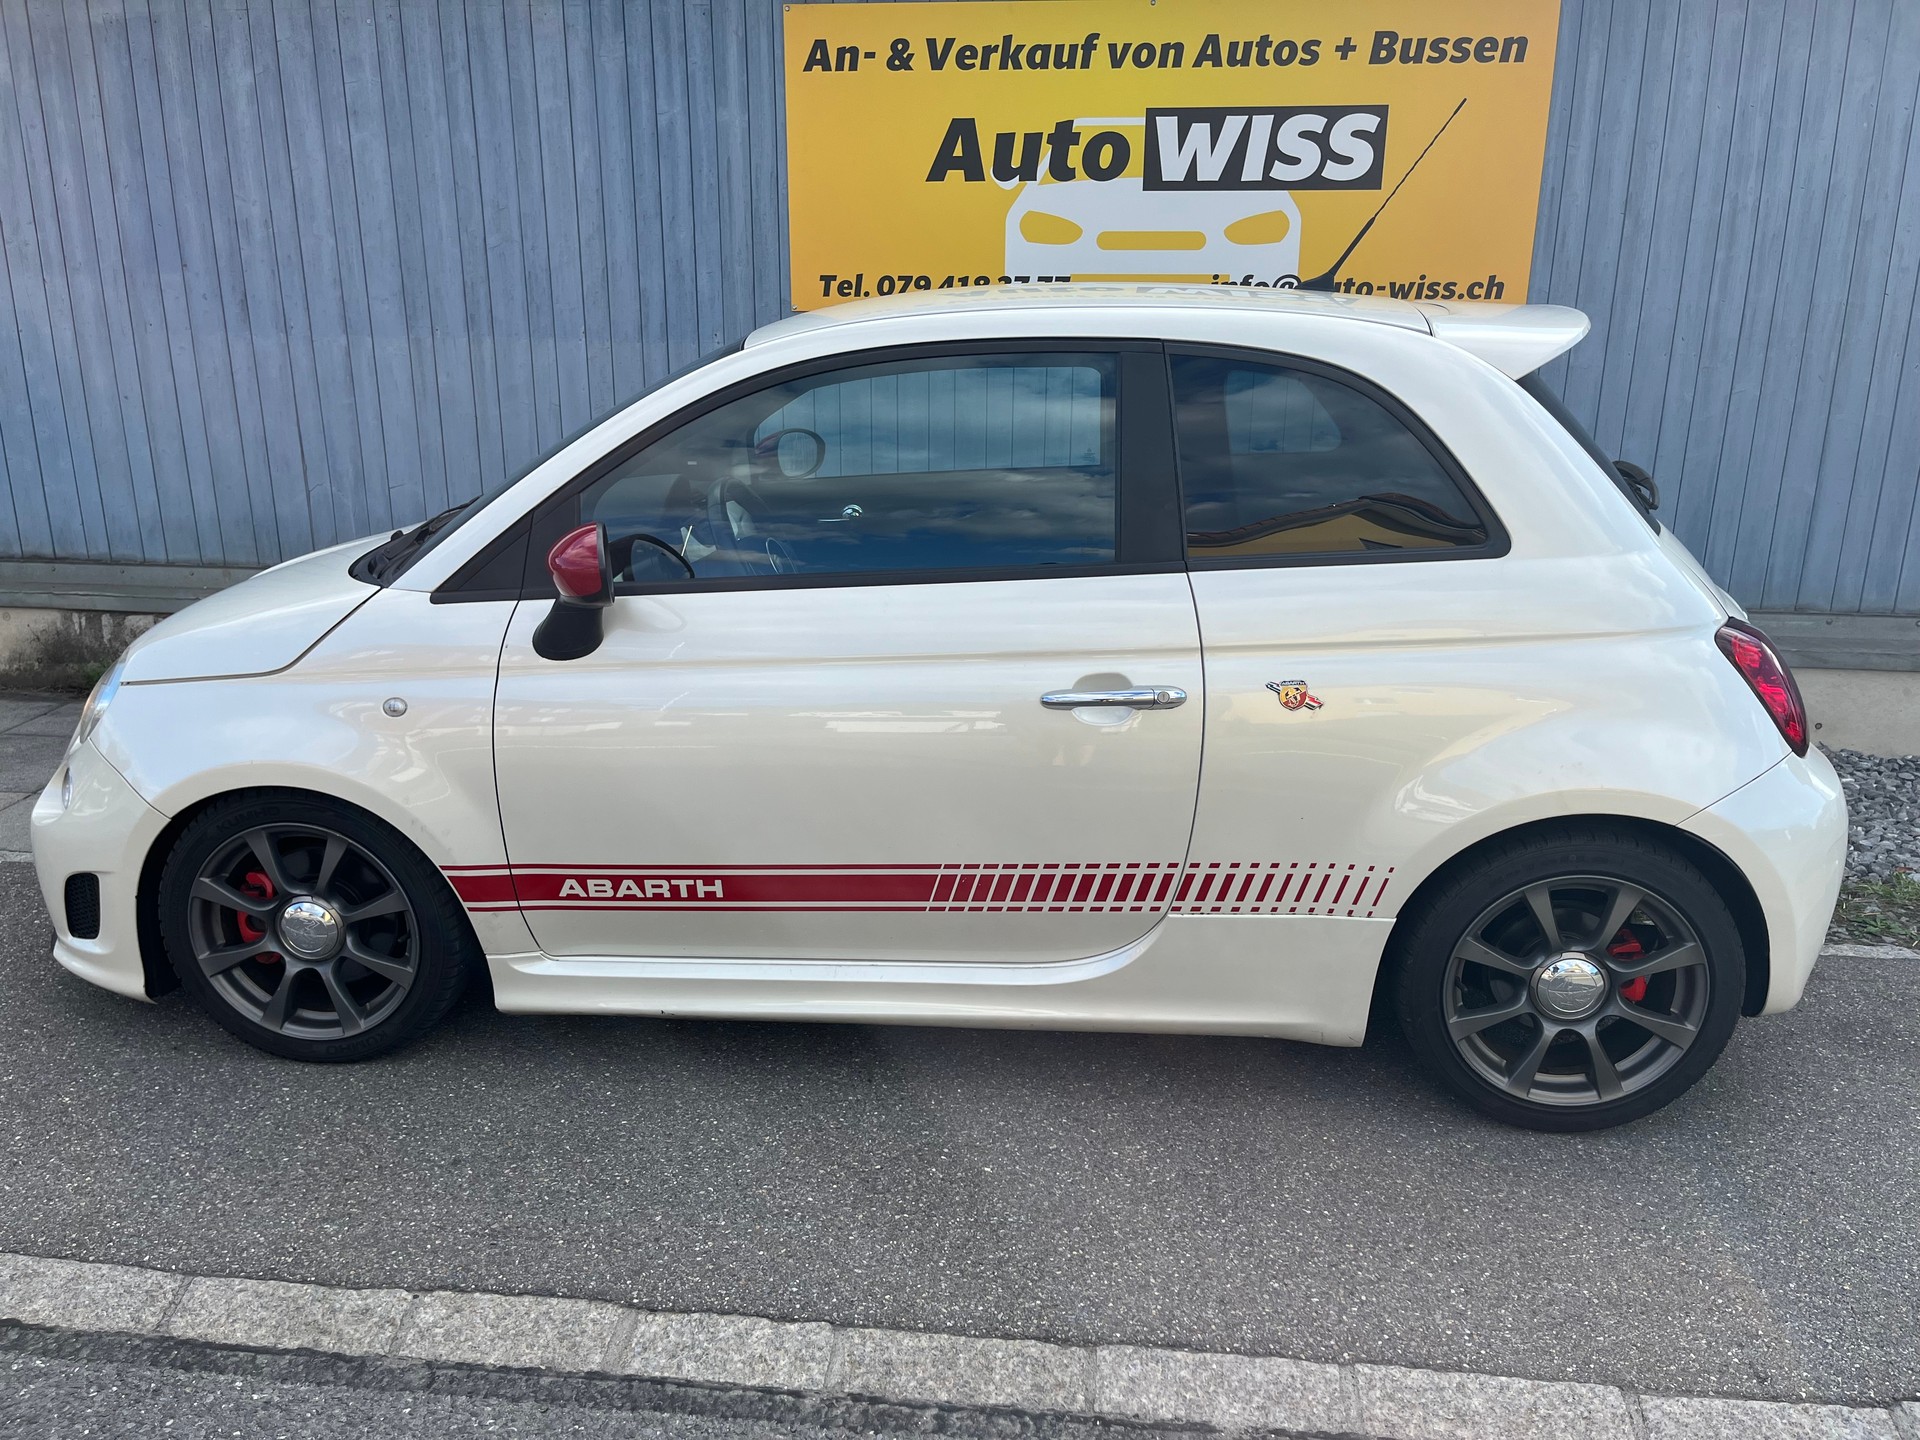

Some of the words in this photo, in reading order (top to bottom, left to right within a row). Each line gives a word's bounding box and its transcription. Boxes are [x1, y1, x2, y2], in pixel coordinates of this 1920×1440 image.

[803, 39, 876, 72] An-
[886, 38, 914, 71] &
[926, 32, 1101, 71] Verkauf
[1107, 41, 1184, 69] von
[1192, 33, 1322, 68] Autos
[1334, 37, 1357, 60] +
[1368, 30, 1529, 65] Bussen
[925, 117, 1131, 182] Auto
[1155, 112, 1381, 182] WISS
[819, 273, 870, 297] Tel.
[876, 275, 932, 297] 079
[558, 878, 724, 898] ABARTH
